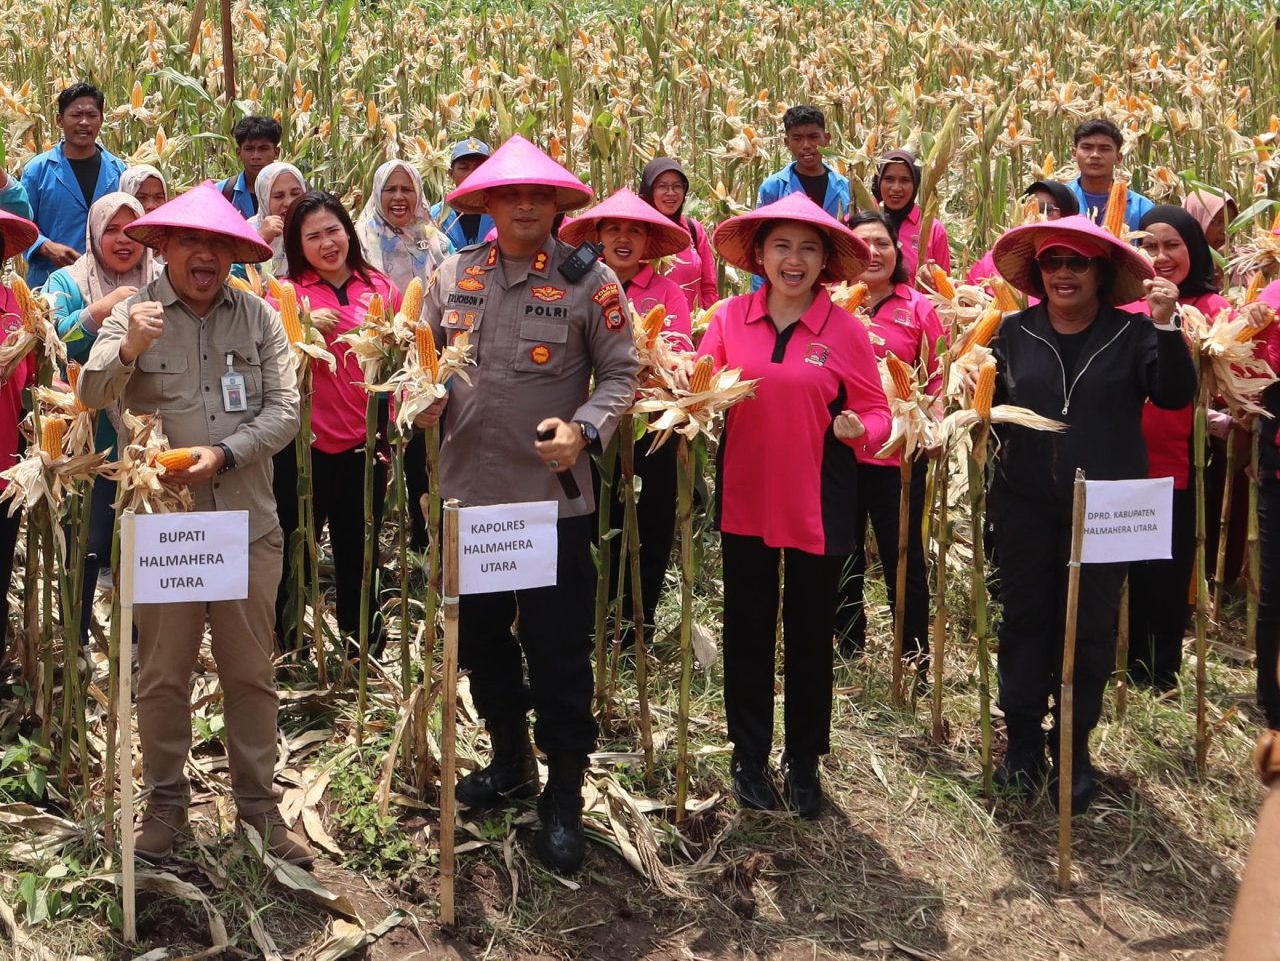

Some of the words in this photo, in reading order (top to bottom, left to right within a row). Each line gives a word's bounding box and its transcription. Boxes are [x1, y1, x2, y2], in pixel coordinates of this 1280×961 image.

[525, 305, 568, 318] POLRI
[1087, 512, 1112, 520] DPRD.
[1114, 508, 1156, 520] KABUPATEN
[471, 519, 526, 535] KAPOLRES
[1083, 525, 1132, 535] HALMAHERA
[1133, 523, 1158, 533] UTARA
[159, 530, 206, 544] BUPATI
[463, 539, 534, 555] HALMAHERA
[139, 553, 225, 568] HALMAHERA
[480, 560, 518, 574] UTARA
[160, 576, 205, 589] UTARA
